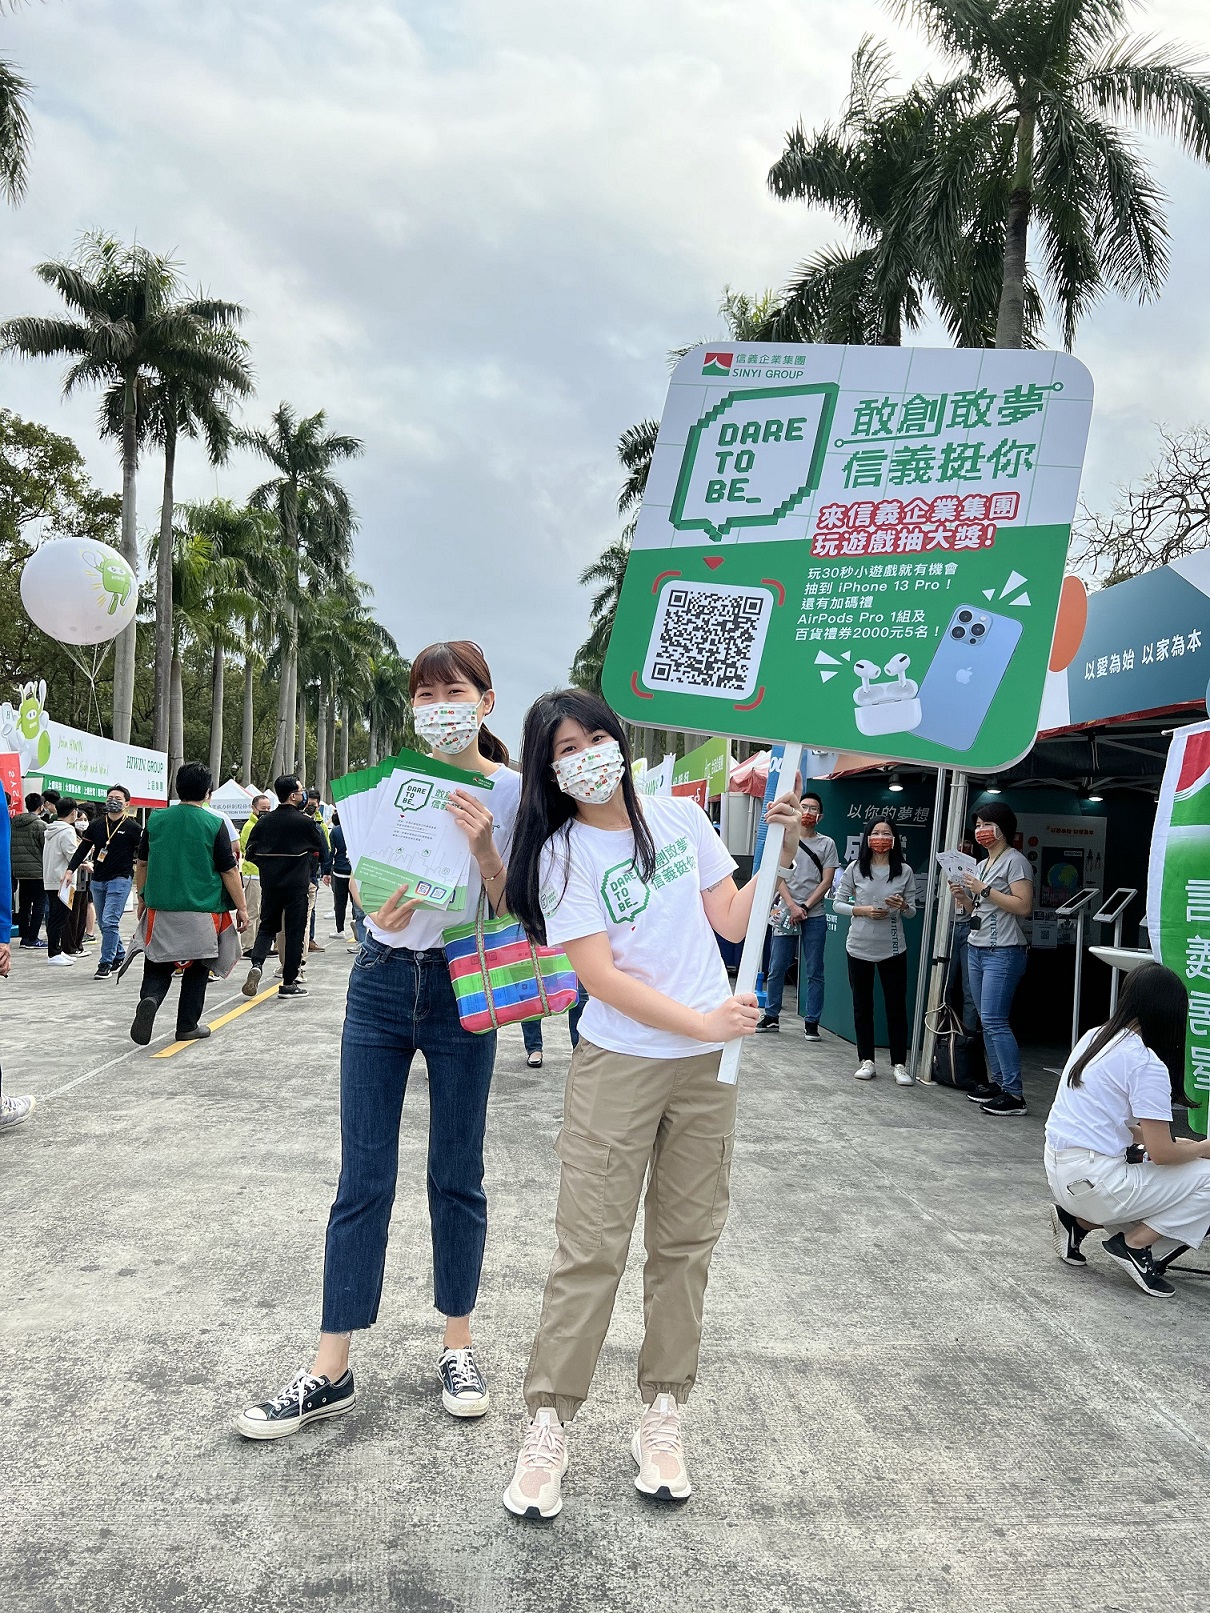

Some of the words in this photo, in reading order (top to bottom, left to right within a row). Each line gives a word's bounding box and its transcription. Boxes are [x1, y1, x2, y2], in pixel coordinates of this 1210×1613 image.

[736, 353, 807, 366] 信義企業集團
[732, 368, 762, 378] SINYI
[765, 369, 804, 379] GROUP
[851, 383, 1045, 436] 敢創敢夢
[718, 417, 807, 446] DARE
[715, 449, 756, 475] TO
[841, 437, 1037, 489] 信義挺你
[820, 494, 1018, 529] 來信義企業集團
[807, 562, 959, 580] 玩30秒小遊戲就有機會
[804, 581, 833, 596] 抽到
[838, 581, 888, 593] iPhone
[893, 580, 909, 591] 13
[800, 595, 874, 611] 還有加碼禮
[797, 613, 854, 625] AirPods
[859, 612, 884, 623] Pro
[890, 610, 926, 624] 1組及
[1084, 648, 1135, 680] 以愛為始
[1141, 628, 1202, 665] 以家為本
[126, 755, 147, 772] HIWIN
[147, 760, 164, 774] GROUP
[406, 791, 415, 799] TO
[407, 785, 427, 794] DARE
[846, 803, 930, 823] 以你的夢想
[609, 871, 637, 892] DARE
[614, 888, 629, 901] TO
